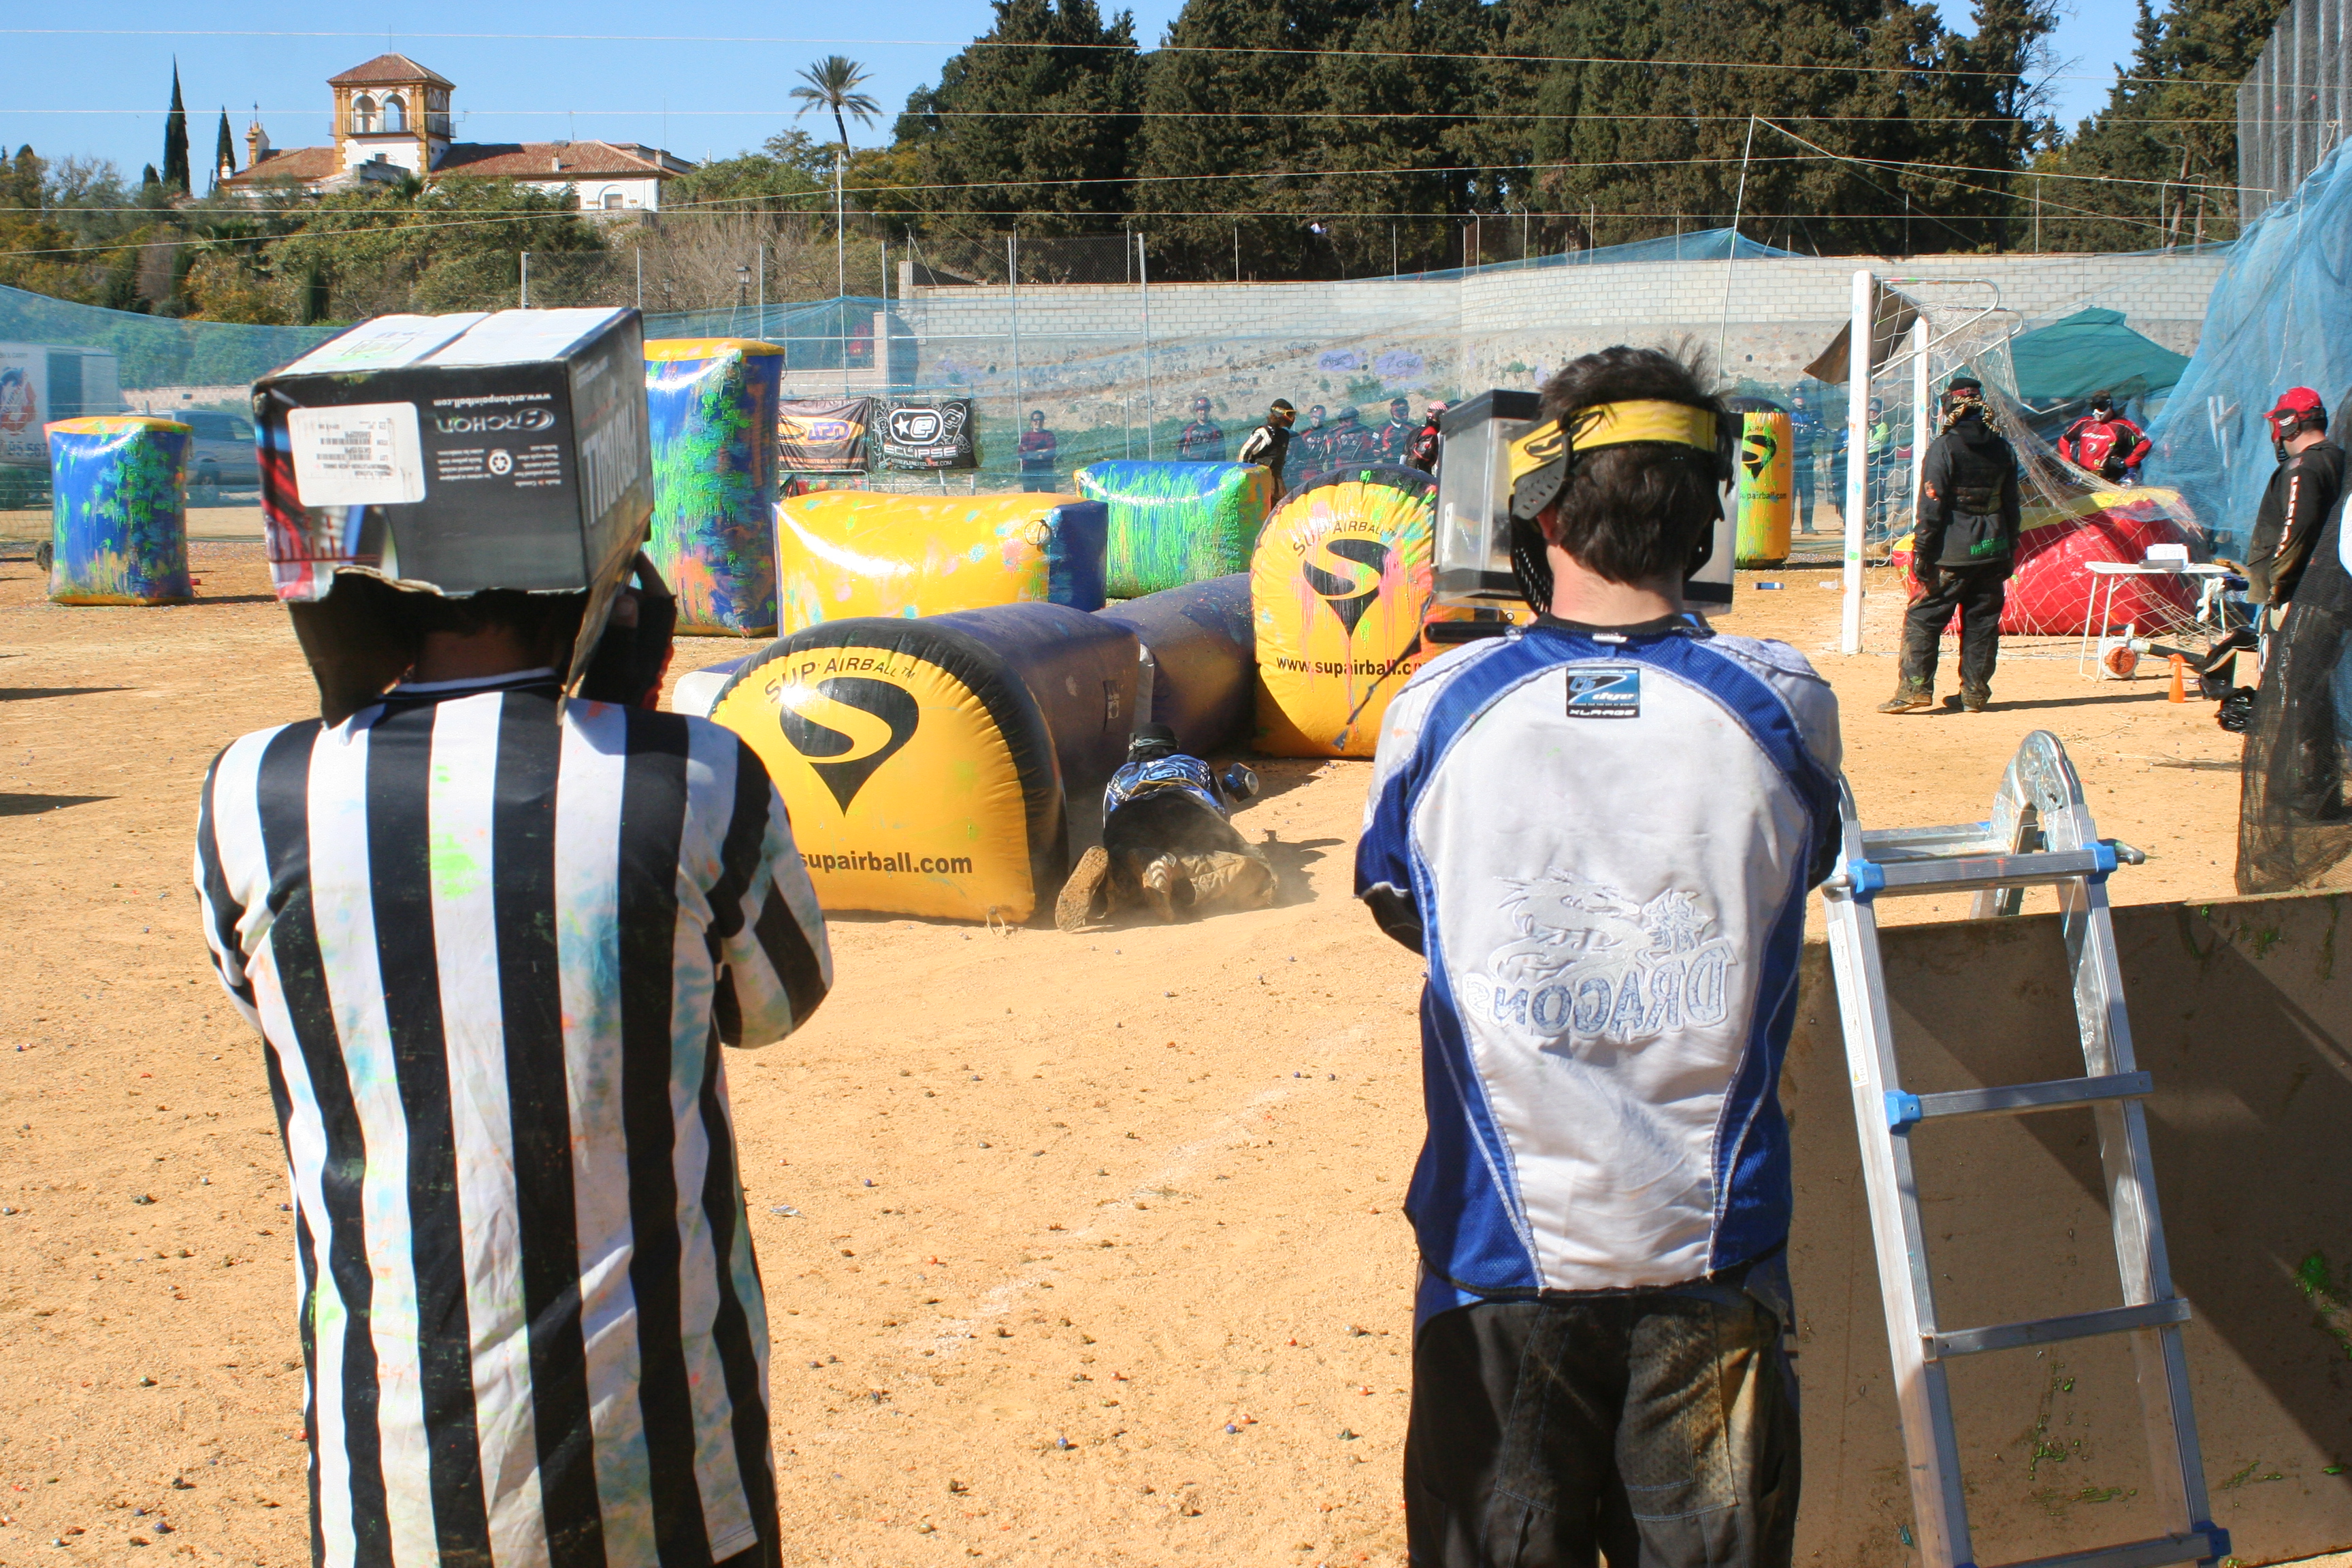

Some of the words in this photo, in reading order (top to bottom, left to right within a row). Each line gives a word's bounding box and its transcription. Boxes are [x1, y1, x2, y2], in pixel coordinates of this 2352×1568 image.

[433, 393, 552, 408] www.archonpaintball.com
[884, 444, 958, 459] ECLIPSE
[1592, 692, 1635, 700] dye
